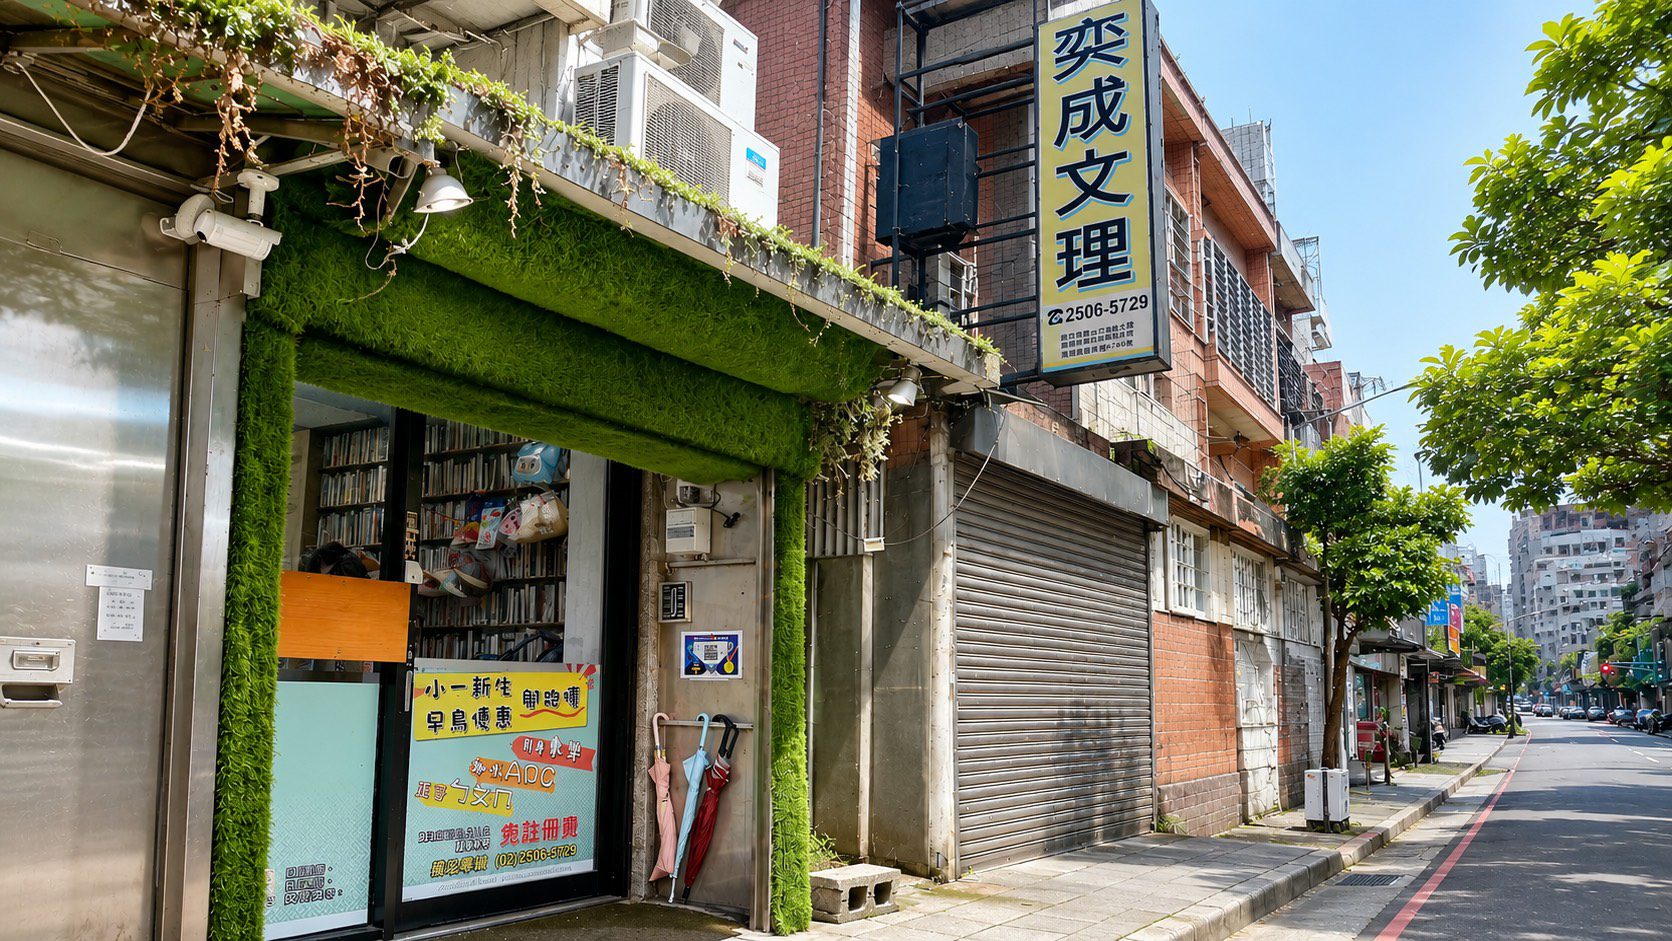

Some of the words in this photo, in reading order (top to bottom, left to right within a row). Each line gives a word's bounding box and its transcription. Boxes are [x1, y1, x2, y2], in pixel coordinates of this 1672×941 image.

[1053, 12, 1132, 290] 奕成文理
[1065, 294, 1148, 322] 2506-5729
